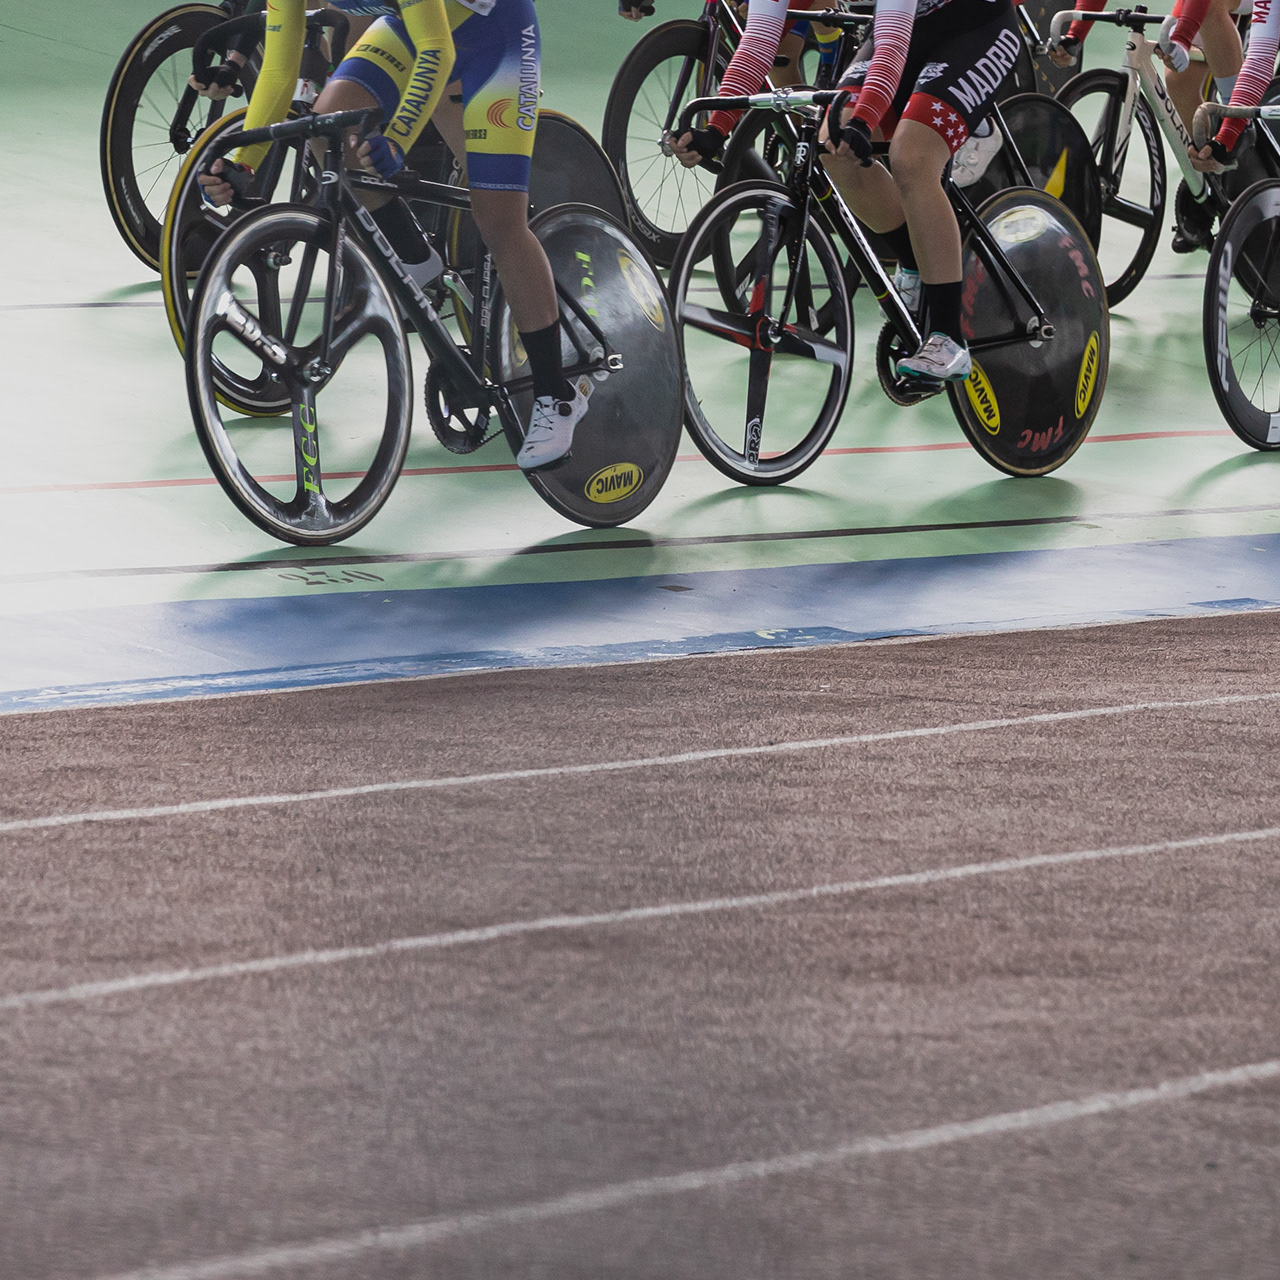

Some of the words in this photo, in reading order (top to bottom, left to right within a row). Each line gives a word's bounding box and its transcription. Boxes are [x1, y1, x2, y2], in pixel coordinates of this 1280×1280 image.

[391, 48, 442, 138] CATALUNYA
[516, 23, 536, 132] CATALUNYA
[947, 28, 1021, 115] MADRID
[355, 205, 442, 323] DOLAN
[969, 369, 997, 422] MAVIC
[1079, 342, 1096, 404] MAVIC
[299, 403, 320, 494] FCC
[596, 470, 634, 495] MAVIC
